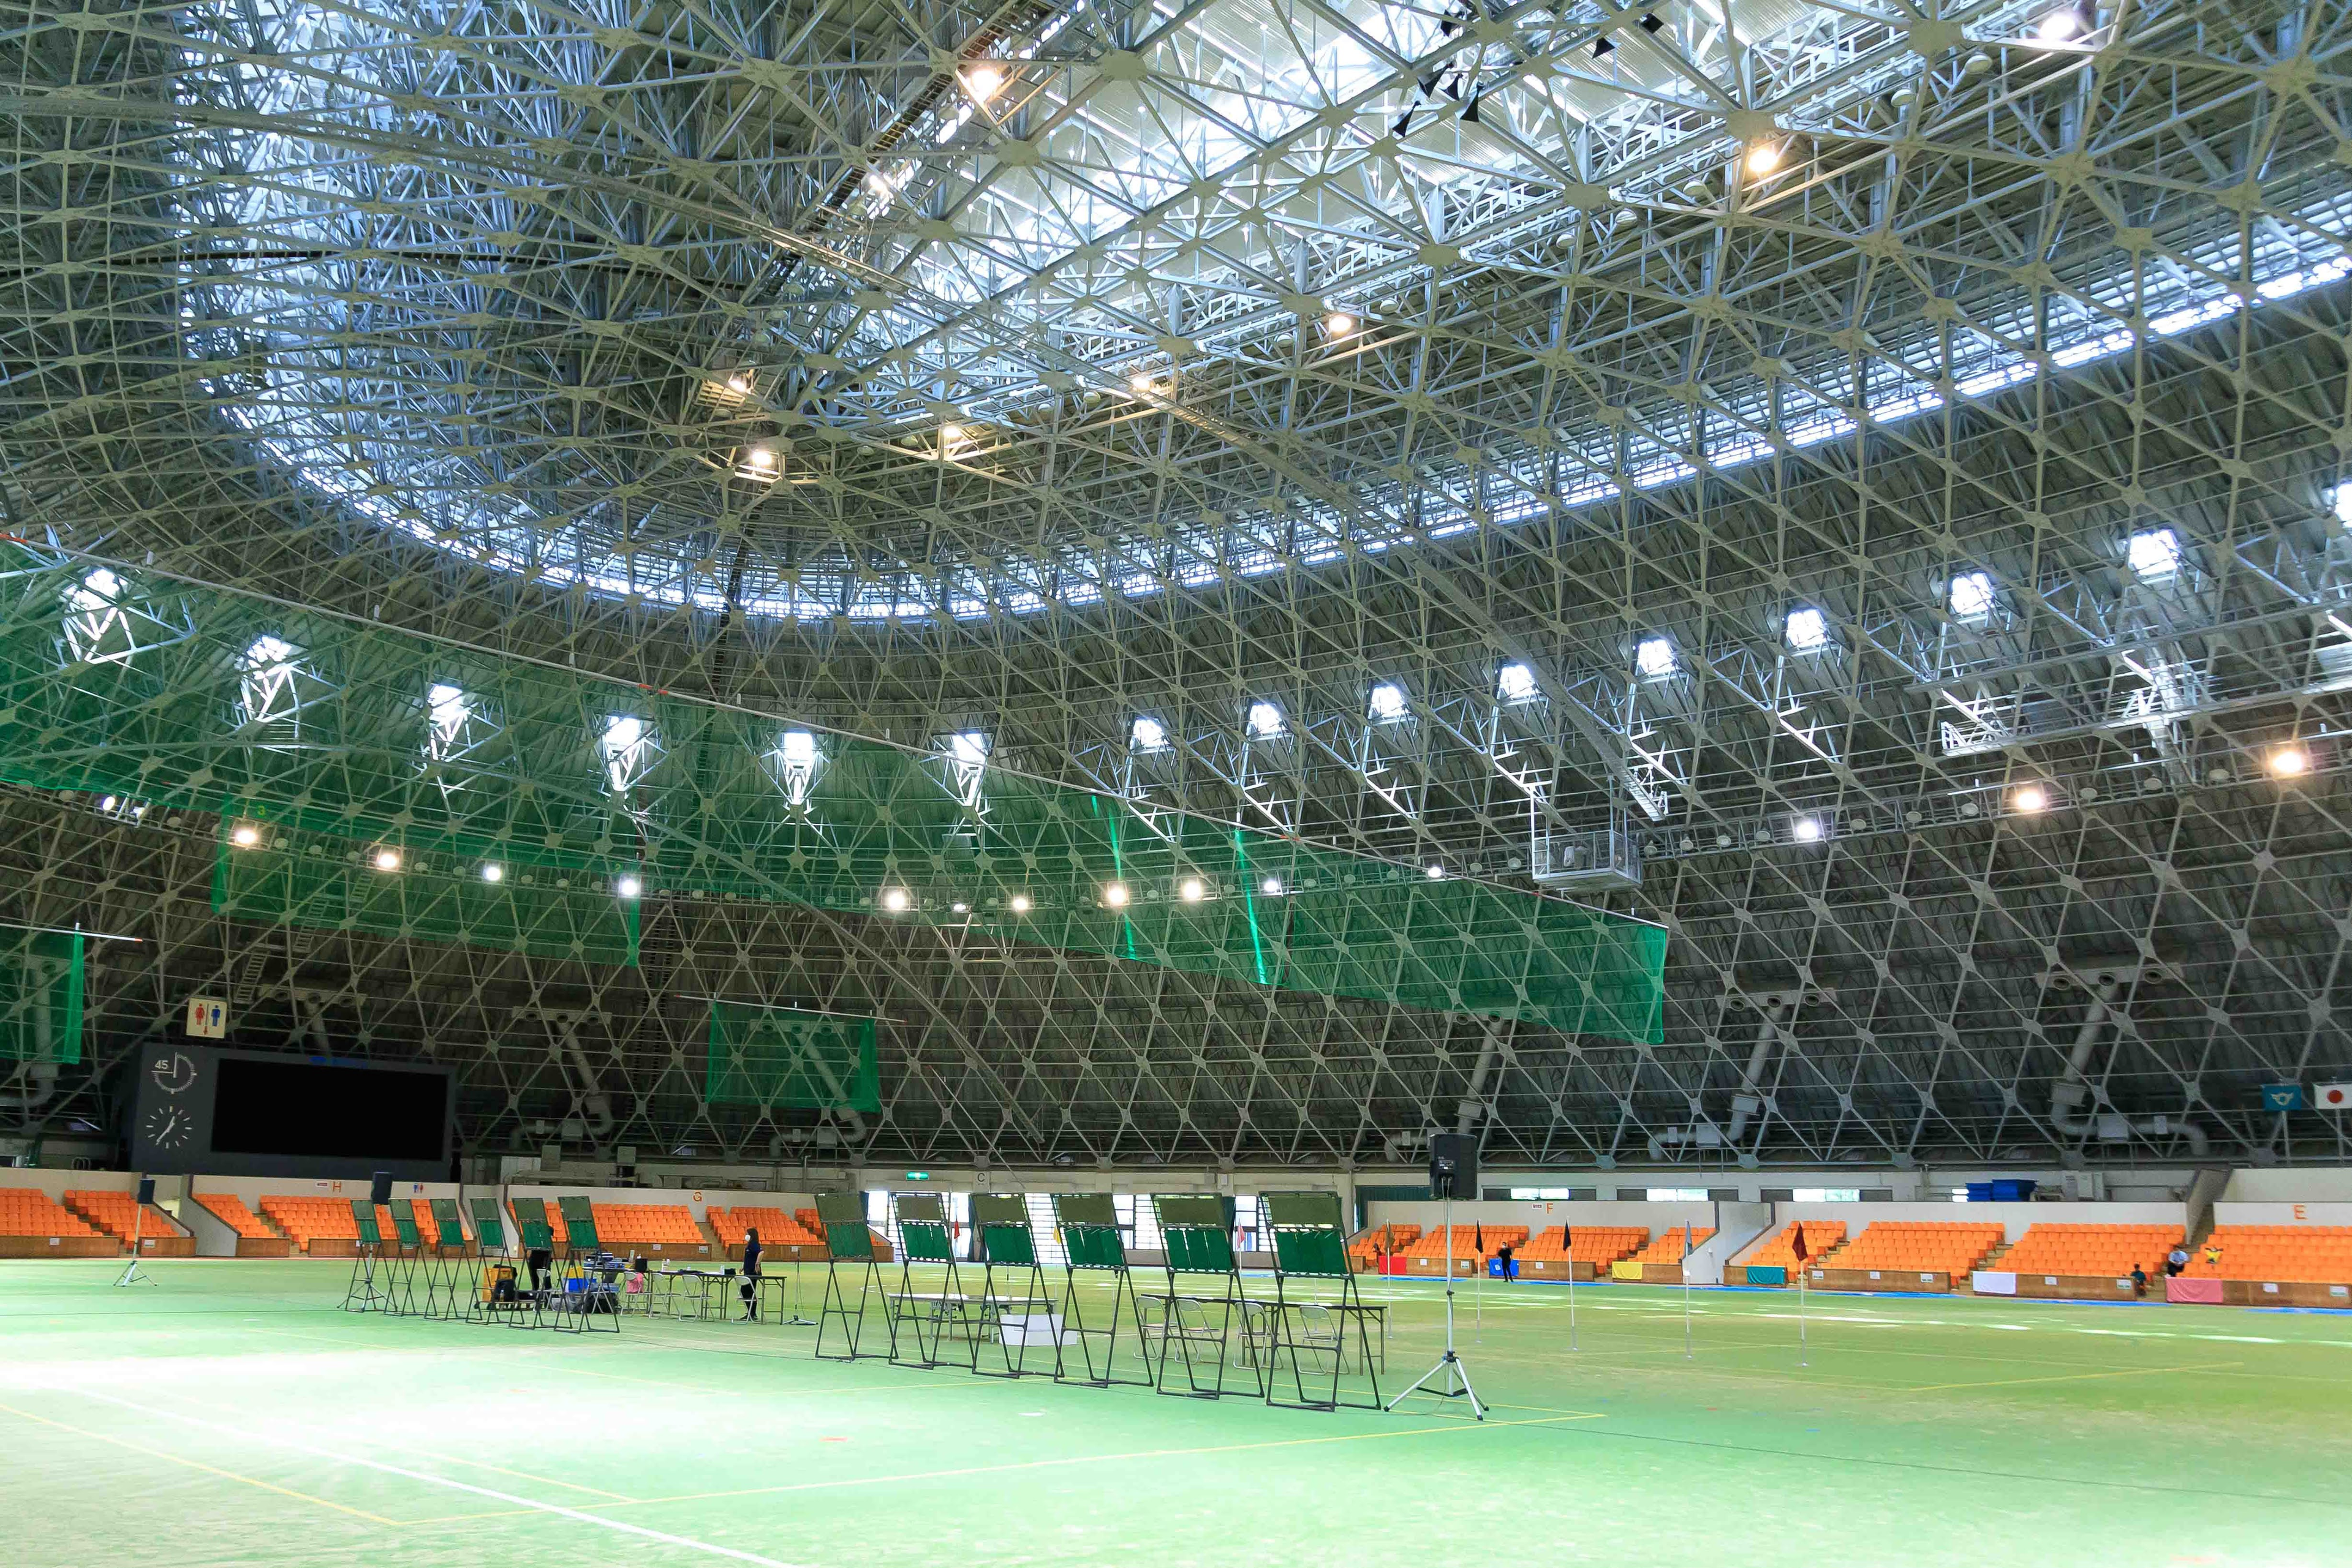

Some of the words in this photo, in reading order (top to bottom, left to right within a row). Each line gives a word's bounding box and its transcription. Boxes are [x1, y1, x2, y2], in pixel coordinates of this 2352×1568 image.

[154, 1060, 168, 1070] 45
[977, 1172, 985, 1182] C
[333, 1181, 342, 1193] H
[693, 1191, 702, 1202] G
[1546, 1202, 1554, 1214] F
[2293, 1204, 2309, 1220] E
